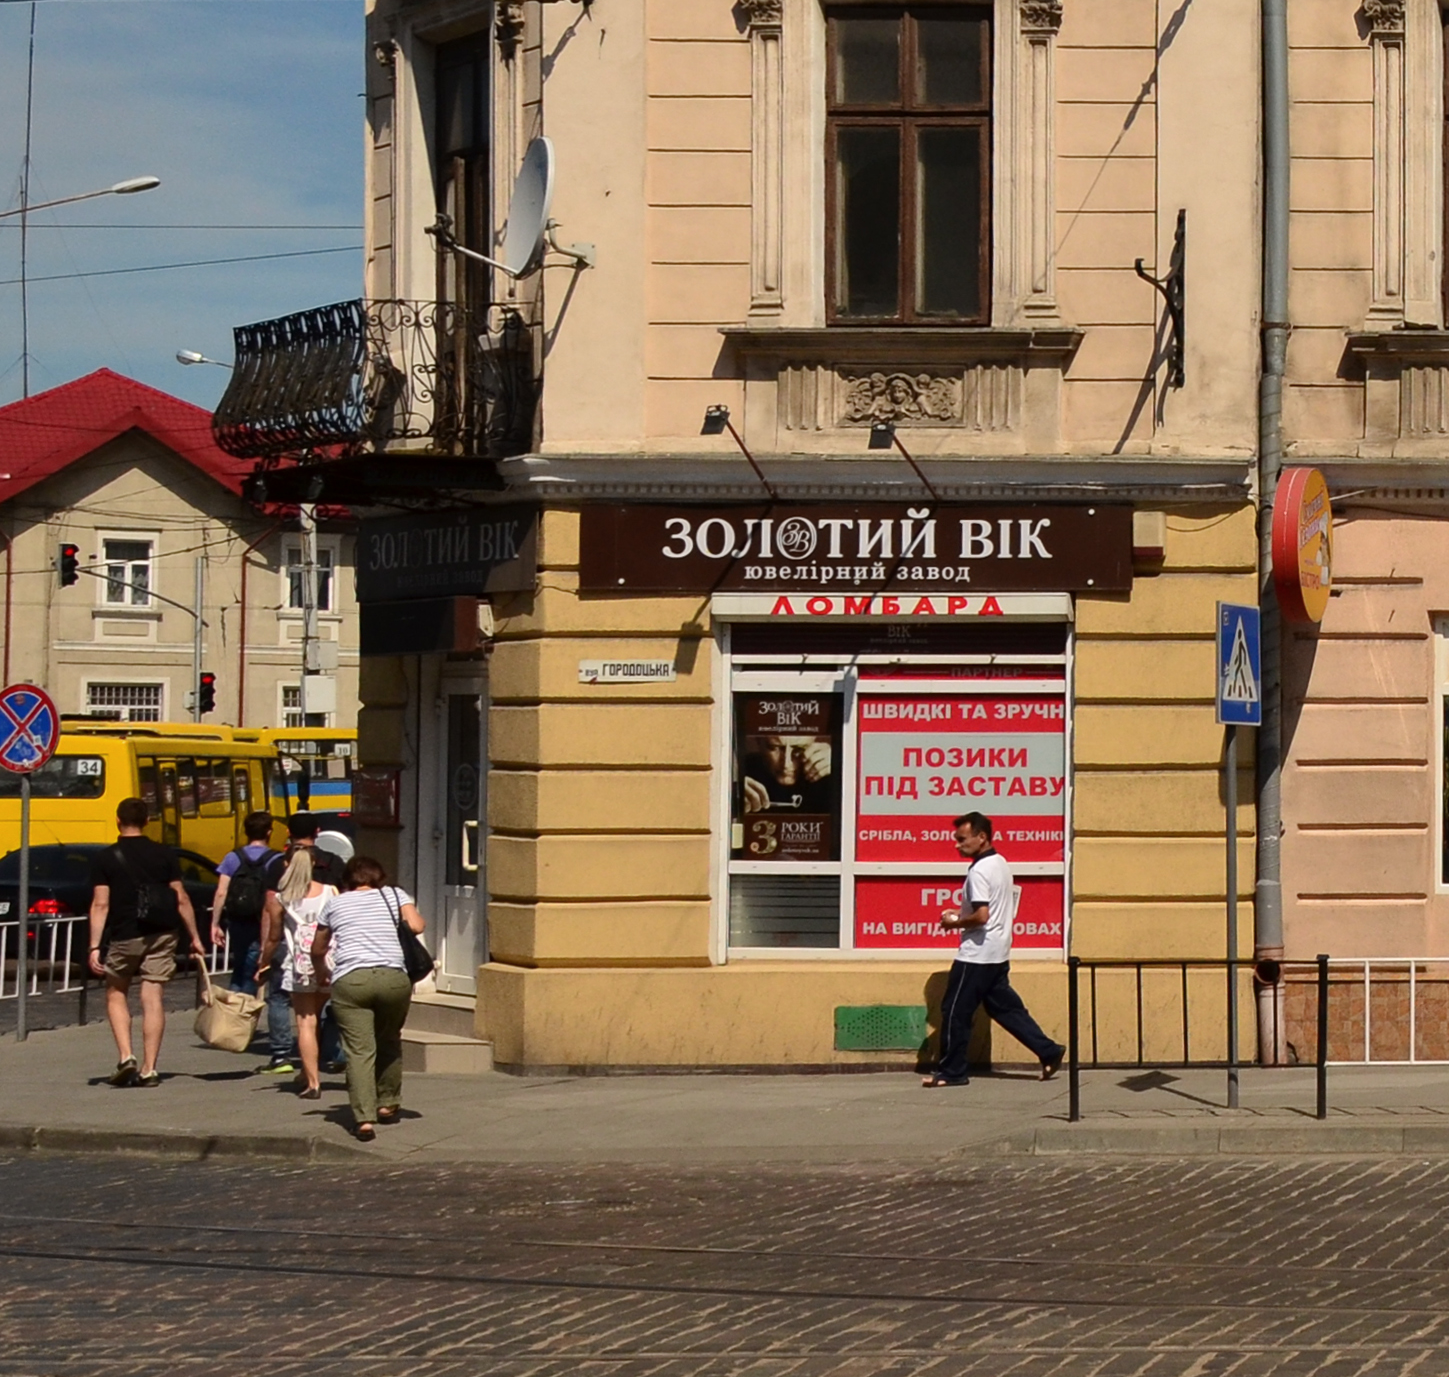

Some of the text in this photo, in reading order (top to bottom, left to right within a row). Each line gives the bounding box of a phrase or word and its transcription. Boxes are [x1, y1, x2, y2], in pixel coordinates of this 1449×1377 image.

[662, 508, 1053, 560] ЗОЛОТИЙ ВІК
[369, 516, 518, 571] ЗОЛОТИЙ ВІК
[744, 560, 970, 585] ювелірний завод
[771, 596, 1004, 615] ЛОМБАРД
[602, 663, 670, 676] ГОРОДОЦЬКА
[951, 668, 1024, 678] ПАРТНЕР
[777, 712, 801, 725] ВІК
[863, 704, 951, 721] ШВИДКІ
[958, 704, 987, 719] ТА
[903, 748, 1027, 767] ПОЗИКИ
[80, 760, 98, 774] 34
[865, 776, 1064, 799] ПІД ЗАСТАВУ
[781, 822, 823, 833] РОКИ
[859, 830, 917, 842] СРІБЛА,
[921, 830, 957, 841] ЗОЛО
[921, 889, 963, 906] ГРО
[863, 923, 887, 935] НА
[1013, 923, 1061, 935] ОВАХ
